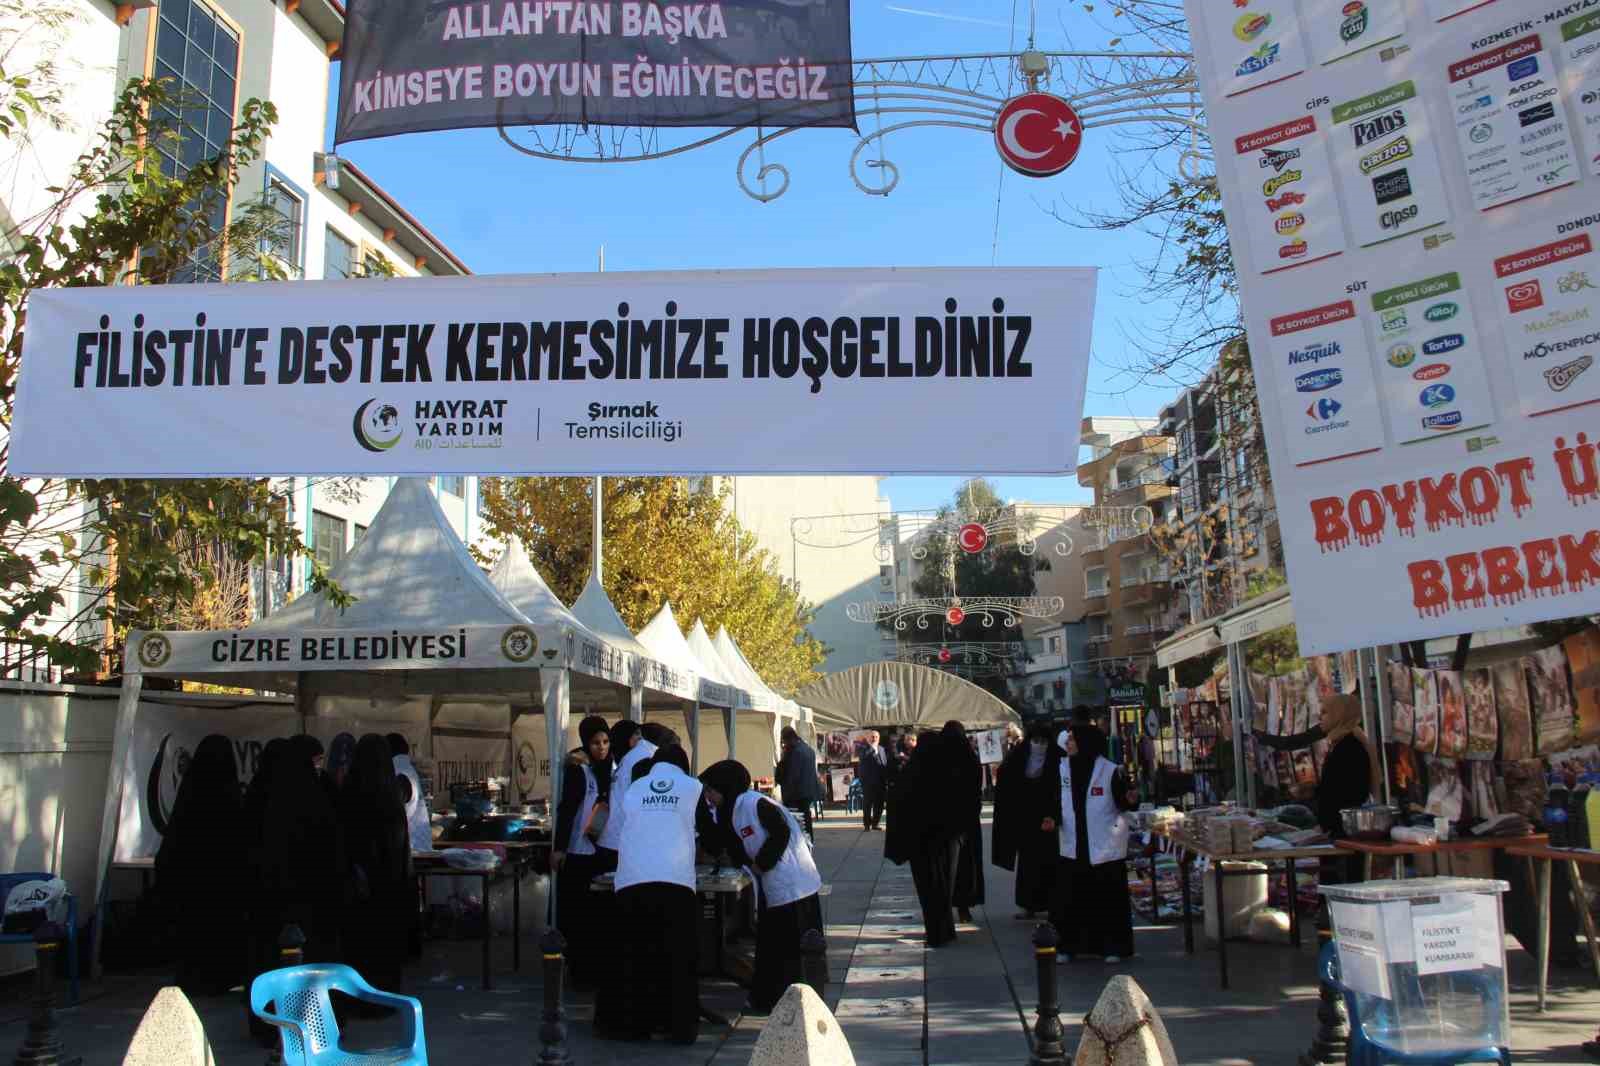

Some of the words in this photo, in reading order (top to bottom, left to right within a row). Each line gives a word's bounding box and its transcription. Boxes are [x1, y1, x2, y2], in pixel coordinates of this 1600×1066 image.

[442, 2, 612, 41] ALLAH'TAN
[621, 3, 728, 45] BAŞKA
[1471, 21, 1534, 50] KOZMETİK
[354, 66, 483, 114] KİMSEYE
[493, 62, 601, 98] BOYUN
[612, 55, 829, 101] EĞMİYECEĞİZ
[1305, 96, 1330, 111] CİPS
[1345, 281, 1369, 293] SÜT
[73, 312, 269, 389] FİLİSTİN'E
[277, 323, 435, 385] DESTEK
[445, 300, 729, 382] KERMESİMİZE
[742, 297, 1033, 394] HOŞGELDİNİZ
[1288, 341, 1342, 365] Nesquik
[1524, 331, 1600, 361] MÖVENPICK
[1295, 371, 1343, 388] DANONE
[415, 399, 508, 419] HAYRAT
[588, 401, 658, 420] Şırnak
[415, 422, 503, 437] YARDIM
[565, 422, 682, 442] Temsilciliği
[1310, 456, 1535, 554] BOYKOT
[212, 633, 290, 662] CİZRE
[301, 629, 467, 660] BELEDİYESİ
[642, 796, 680, 807] HAYRAT
